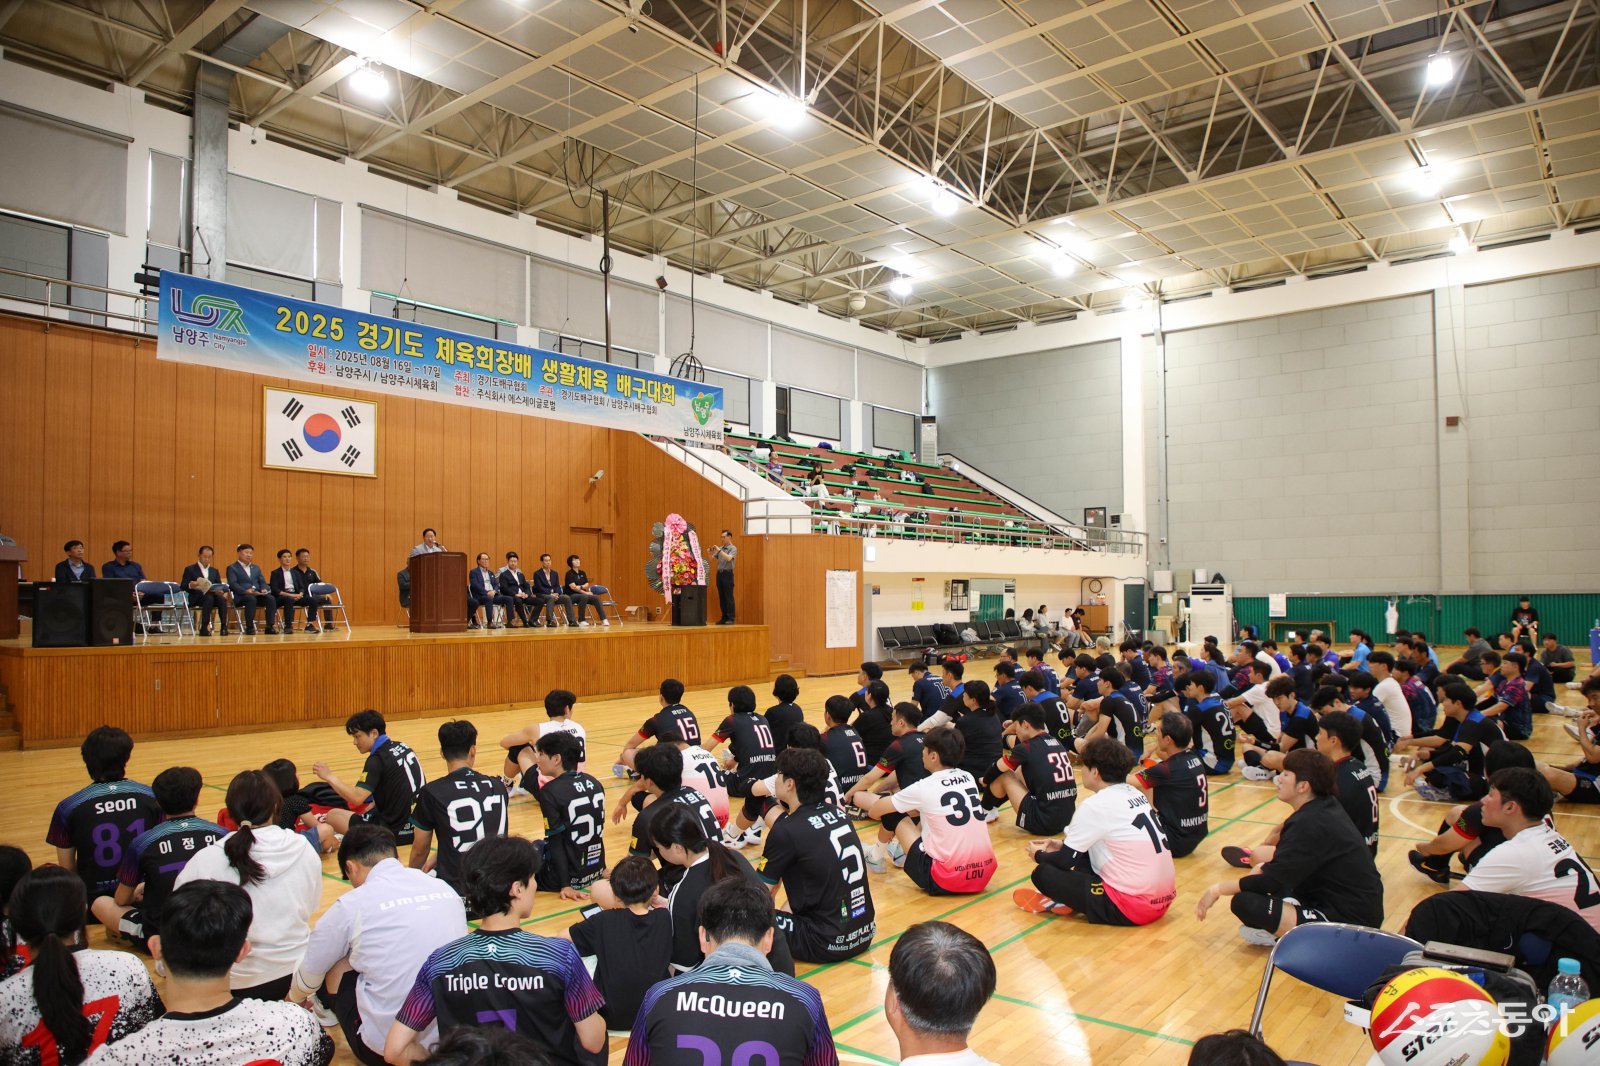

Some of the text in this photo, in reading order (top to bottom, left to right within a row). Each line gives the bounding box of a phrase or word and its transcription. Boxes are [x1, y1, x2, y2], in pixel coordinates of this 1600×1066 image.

[172, 326, 209, 347] 남양주
[214, 343, 226, 351] City
[276, 306, 676, 406] 2025 경기도 체육회장배 생활체육 배구대회
[308, 344, 326, 359] 일시
[336, 350, 368, 366] 2025년
[370, 357, 390, 370] 08월
[393, 360, 412, 374] 16일
[422, 366, 440, 379] 17일
[308, 360, 326, 375] 후원
[336, 364, 372, 382] 남양주시
[380, 372, 438, 392] 남양주시체육회
[454, 370, 470, 384] 주최
[477, 374, 528, 393] 경기도배구협회
[454, 384, 470, 398] 협찬
[476, 388, 506, 404] 주식회사
[508, 394, 556, 412] 에스제이글로벌
[540, 385, 554, 398] 주관
[562, 389, 605, 408] 경기도배구협회
[611, 398, 658, 416] 남양주시배구협회
[683, 426, 722, 441] 남양주시체육회
[1056, 701, 1069, 724] 8
[676, 717, 698, 741] 15
[754, 724, 774, 748] 10
[852, 742, 866, 768] 6
[1048, 752, 1074, 782] 38
[694, 760, 726, 790] 18
[941, 774, 970, 787] CHAN
[1128, 796, 1148, 809] JUNG
[1196, 774, 1207, 808] 3
[1368, 785, 1378, 822] 8
[94, 798, 137, 814] seon
[568, 792, 605, 845] 53
[940, 788, 986, 826] 35
[446, 794, 506, 853] 97
[830, 824, 864, 885] 5
[954, 862, 983, 872] VOLLEYBALL
[965, 869, 984, 880] LOV
[445, 972, 544, 994] Triple Crown
[676, 991, 785, 1020] McQueen
